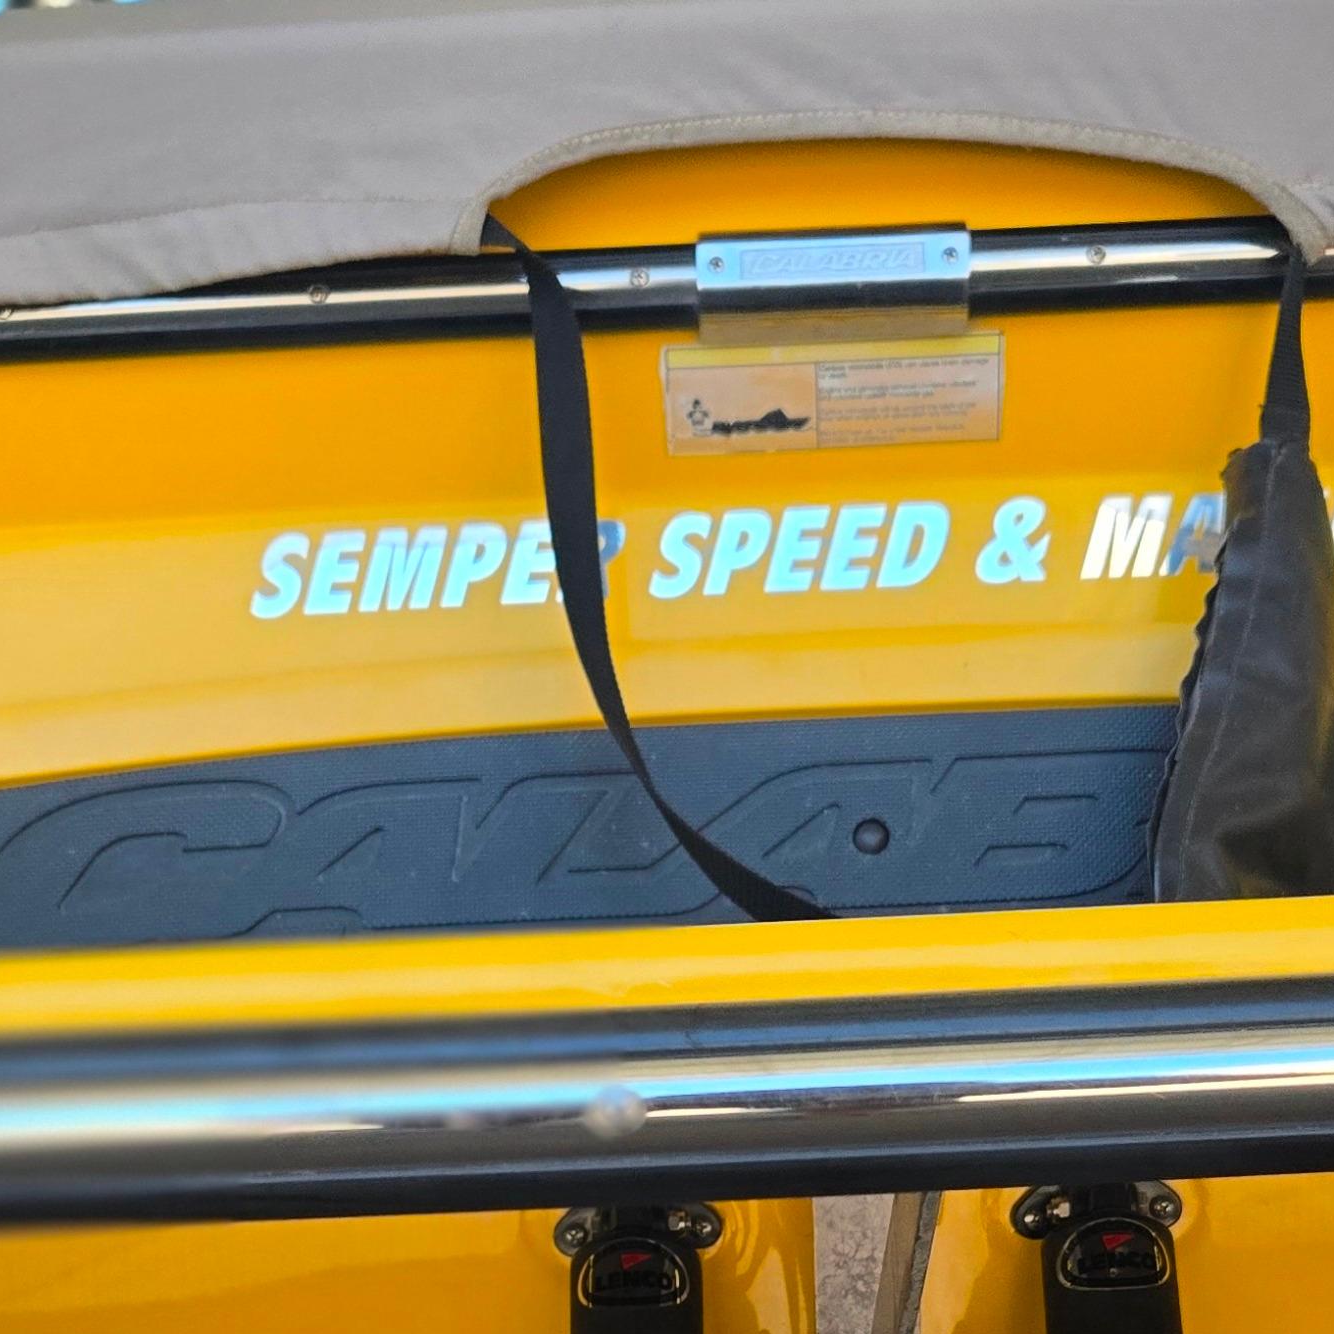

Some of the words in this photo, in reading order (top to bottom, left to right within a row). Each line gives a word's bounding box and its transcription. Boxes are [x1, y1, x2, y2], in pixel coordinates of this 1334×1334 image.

[751, 248, 917, 275] CALABRIA
[647, 499, 952, 601] SPEED
[973, 494, 1053, 585] &
[594, 1269, 674, 1292] LENCO
